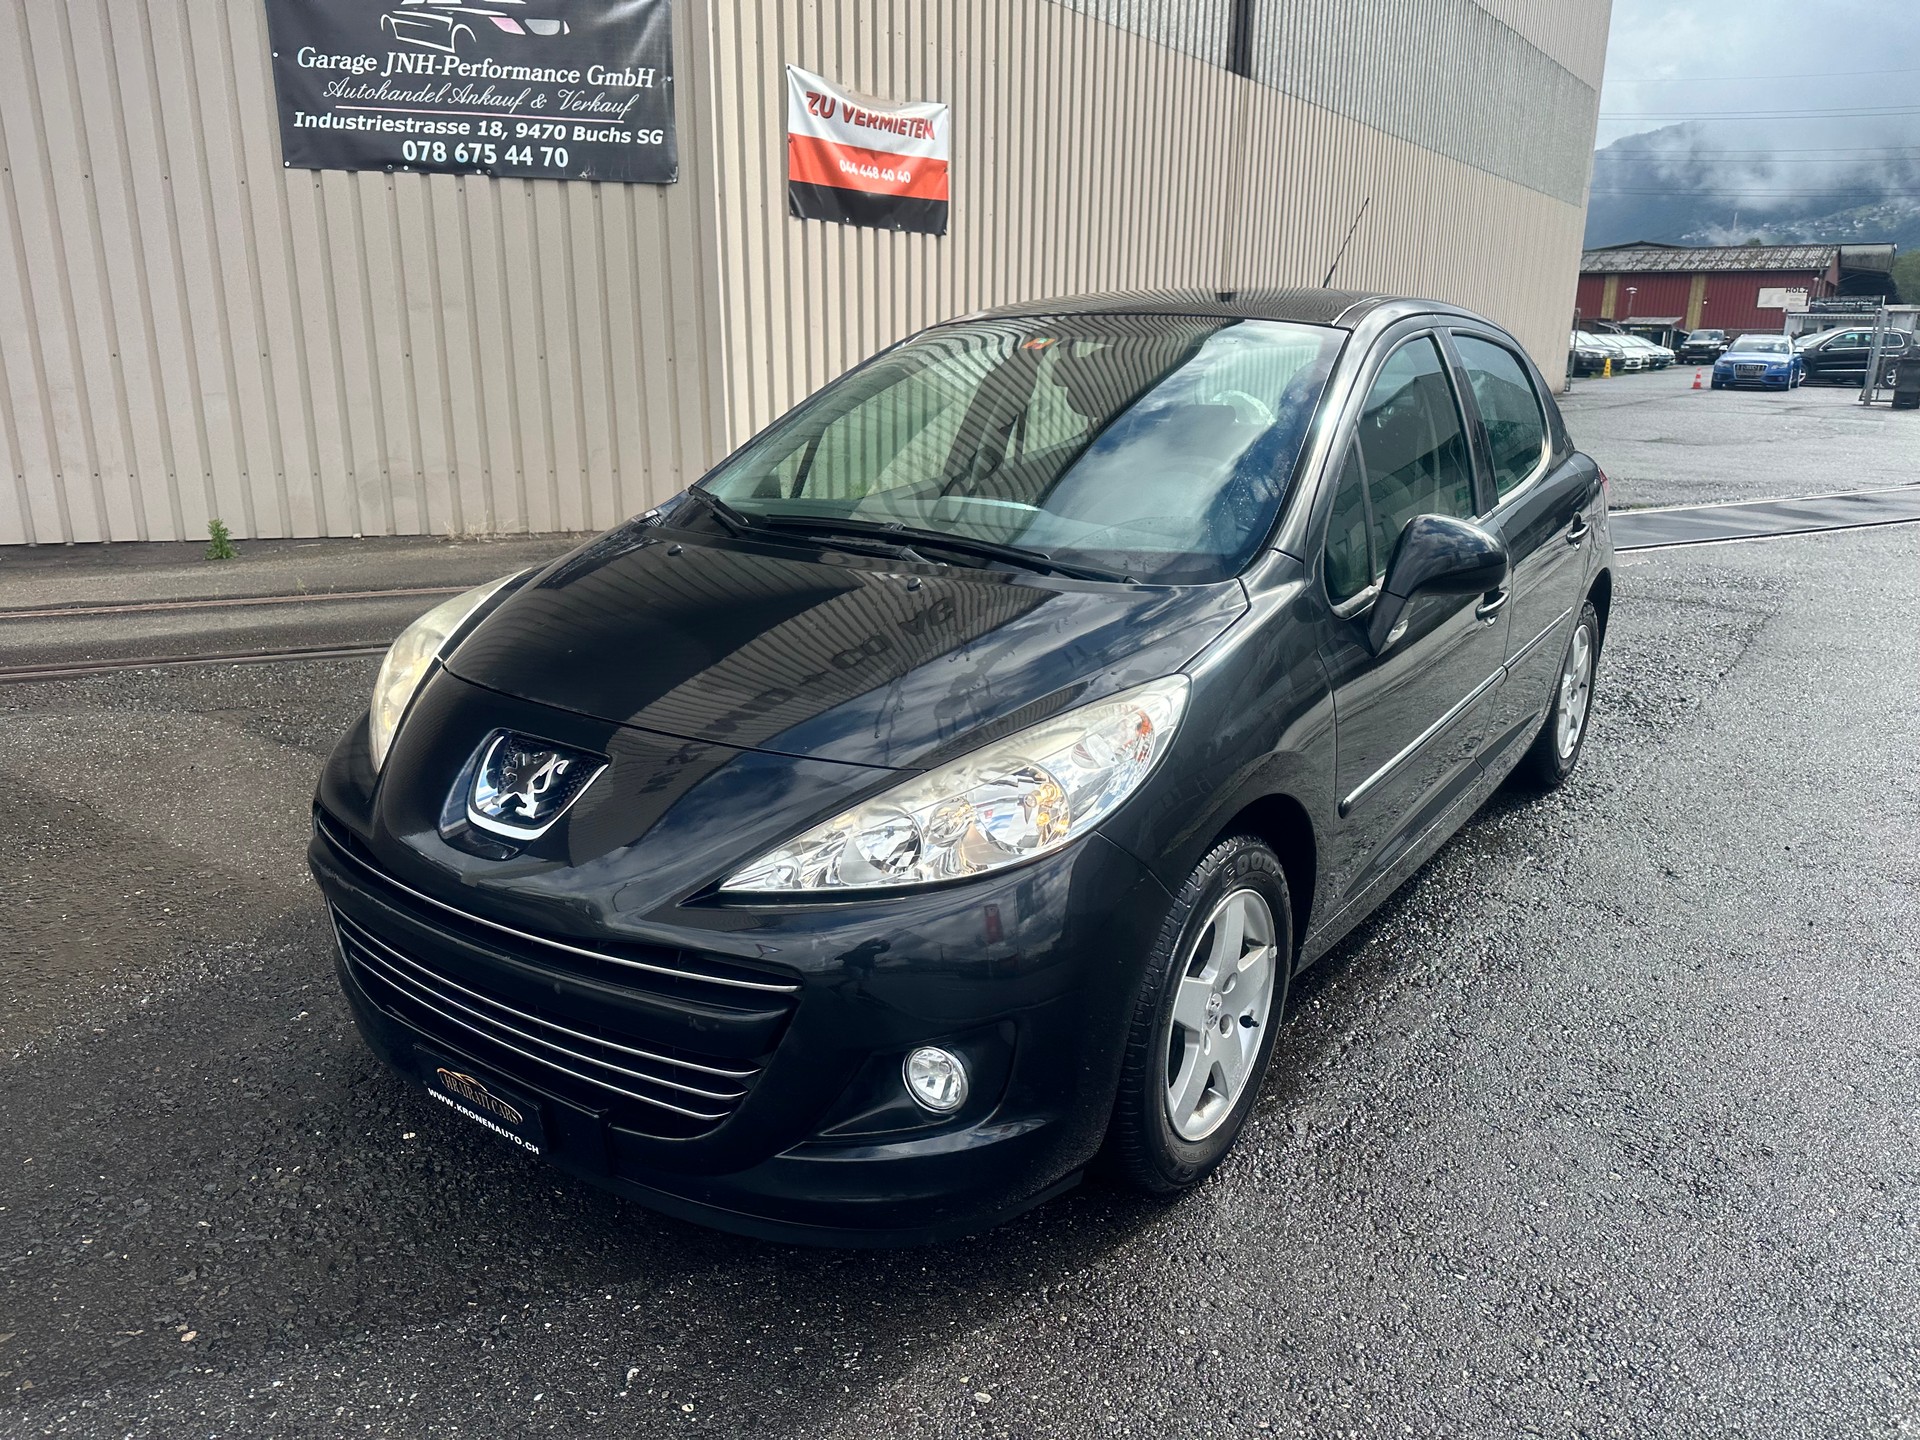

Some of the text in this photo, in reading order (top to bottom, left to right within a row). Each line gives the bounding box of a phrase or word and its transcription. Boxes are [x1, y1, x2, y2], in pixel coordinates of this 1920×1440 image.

[297, 46, 656, 89] Garage JNH-Performance GmbH
[322, 78, 639, 116] Autohandel Ankauf & Verkauf
[806, 91, 936, 140] ZU VERMIETEN
[293, 111, 664, 145] Industriestrasse 18, 9470 Buchs SG
[402, 140, 569, 167] 078 675 44 70
[839, 160, 911, 183] 044 448 40 40
[427, 1087, 540, 1155] WWW.KRONENAUTO.CH
